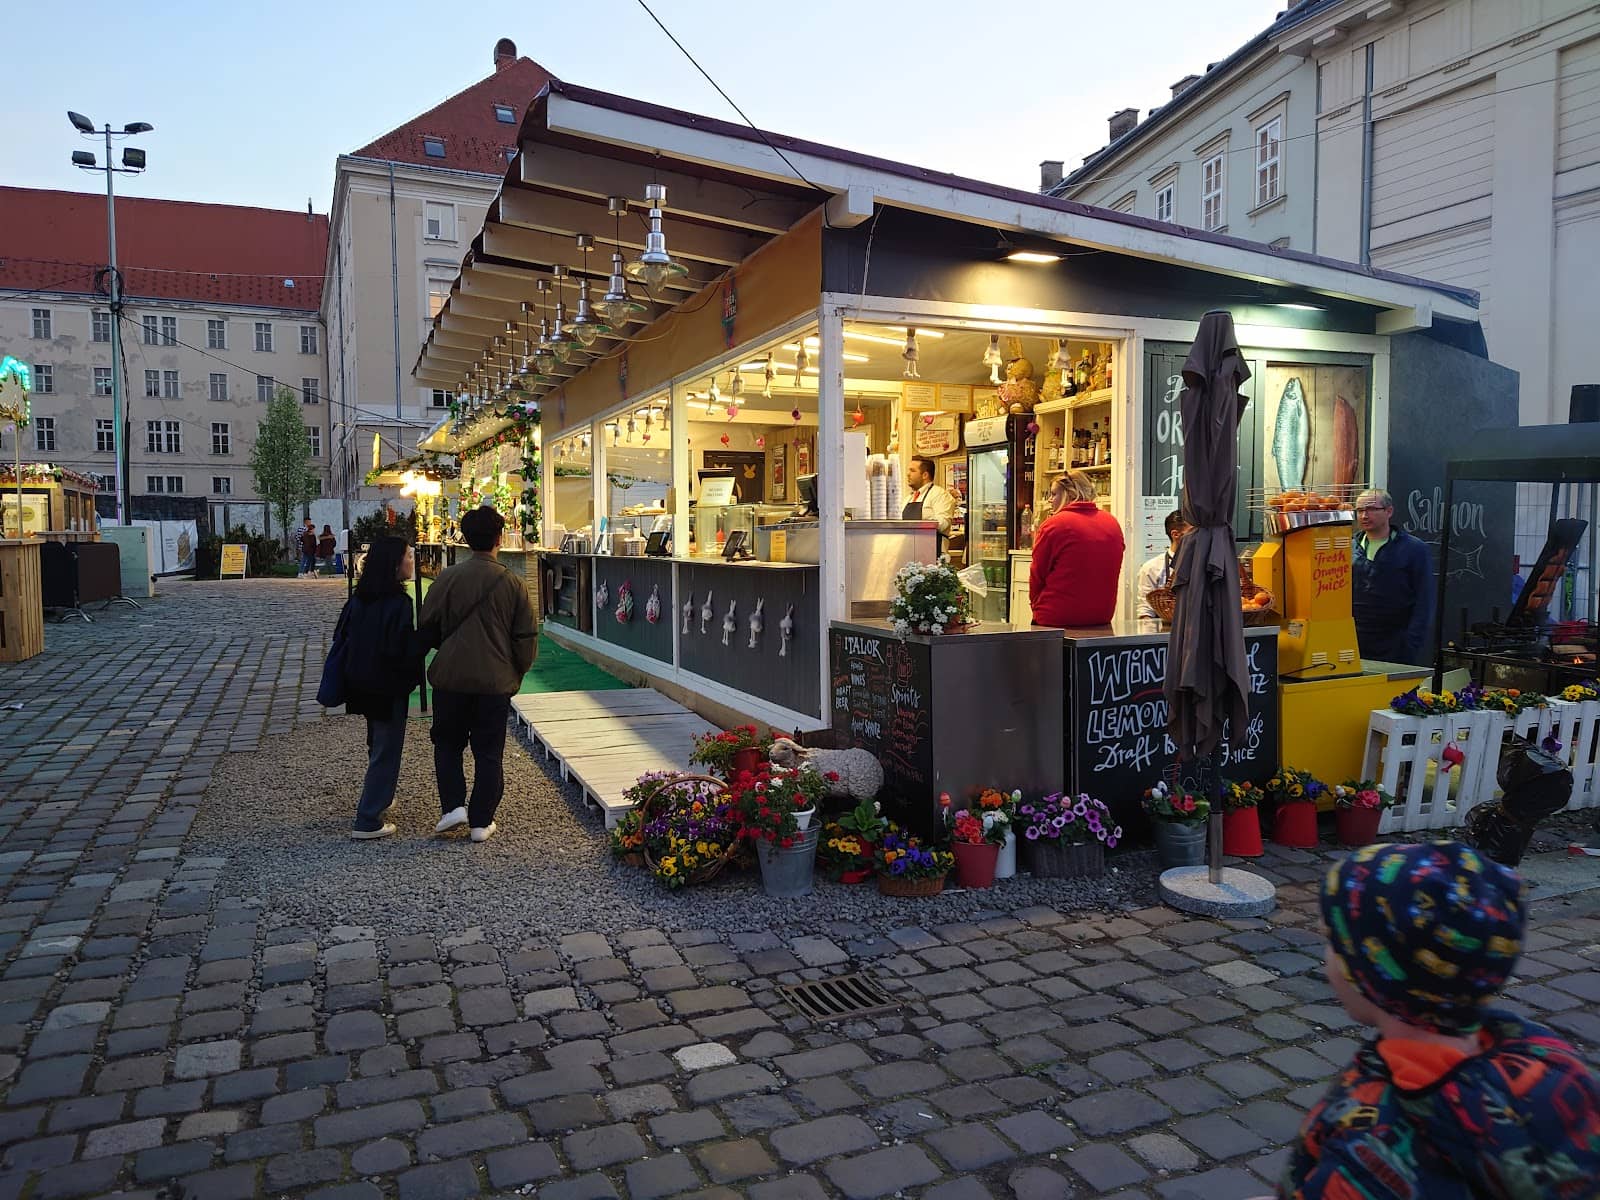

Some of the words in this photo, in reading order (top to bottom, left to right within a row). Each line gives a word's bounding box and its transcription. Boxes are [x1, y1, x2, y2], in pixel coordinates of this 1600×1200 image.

[1403, 486, 1488, 539] Salmon
[1312, 563, 1350, 581] Orange
[1314, 550, 1346, 566] Fresh
[844, 636, 885, 665] ITALOK
[1088, 647, 1168, 705] WiN
[835, 696, 849, 712] BEER
[1086, 700, 1170, 744] LEMON
[1221, 712, 1264, 749] Onge
[1093, 734, 1160, 773] Draft
